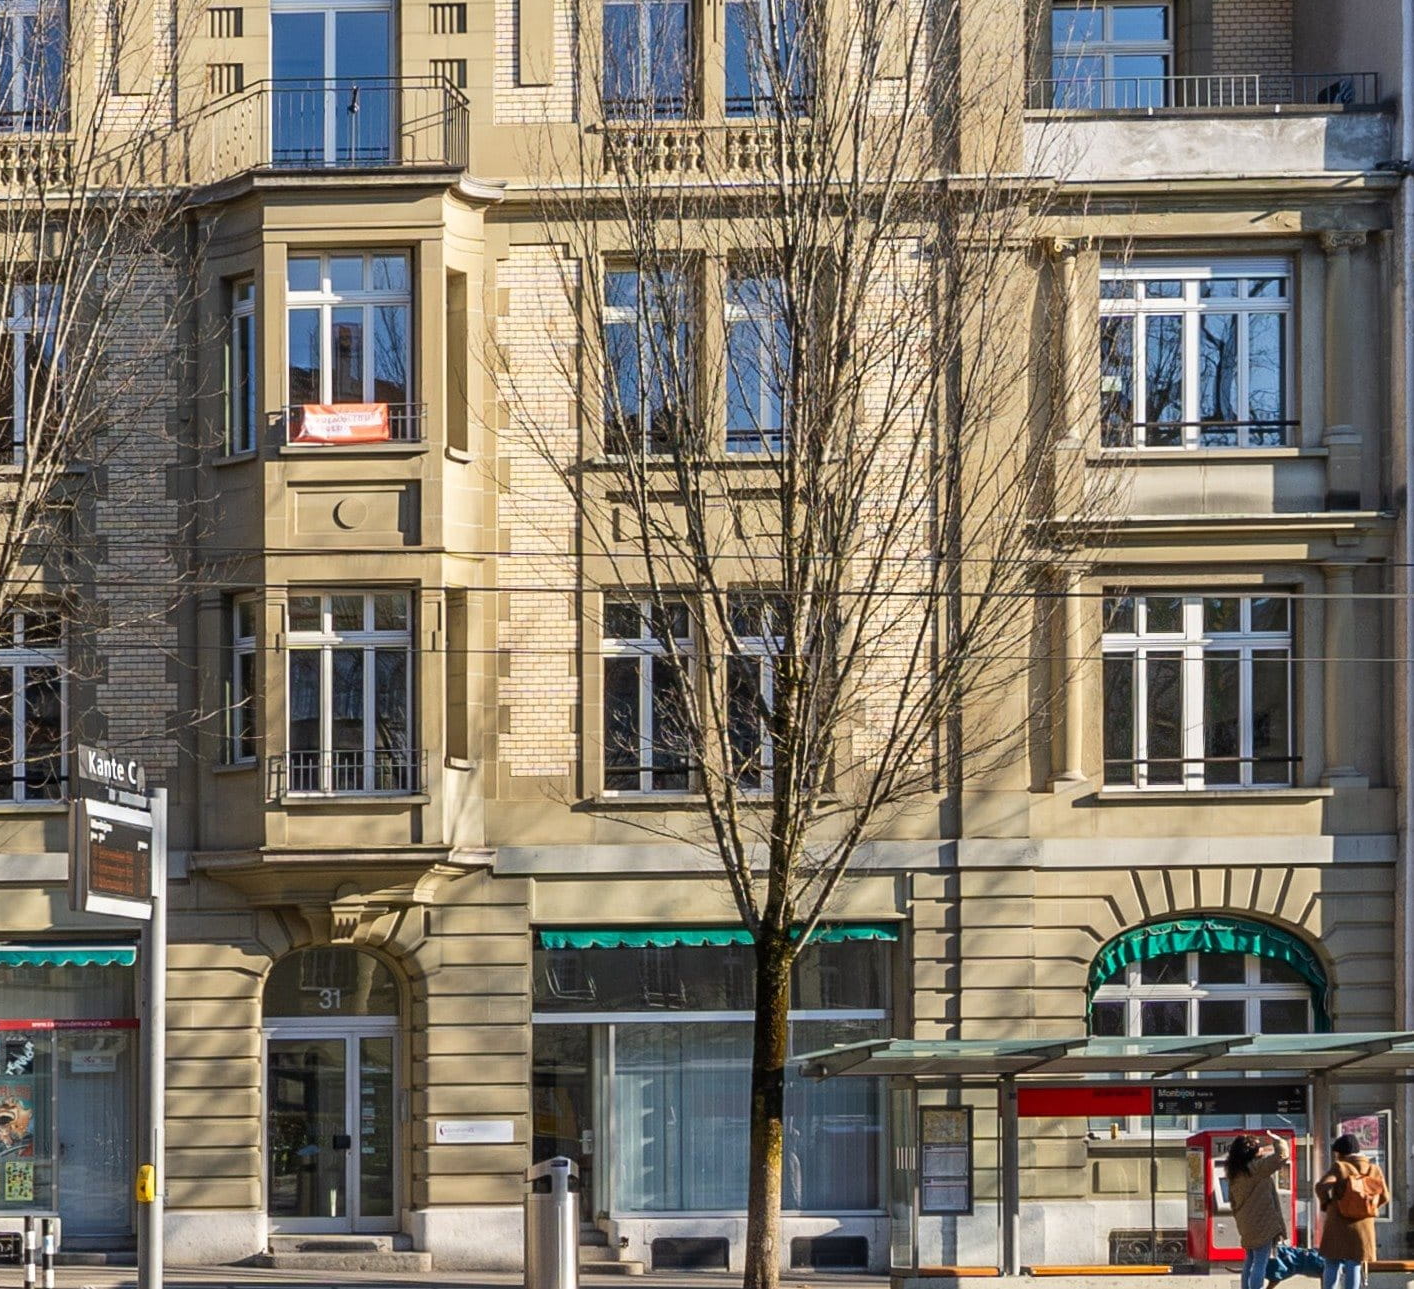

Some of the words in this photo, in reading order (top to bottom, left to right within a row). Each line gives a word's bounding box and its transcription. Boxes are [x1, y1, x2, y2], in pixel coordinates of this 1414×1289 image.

[88, 750, 124, 781] Kante
[128, 761, 137, 784] C
[319, 989, 341, 1009] 31
